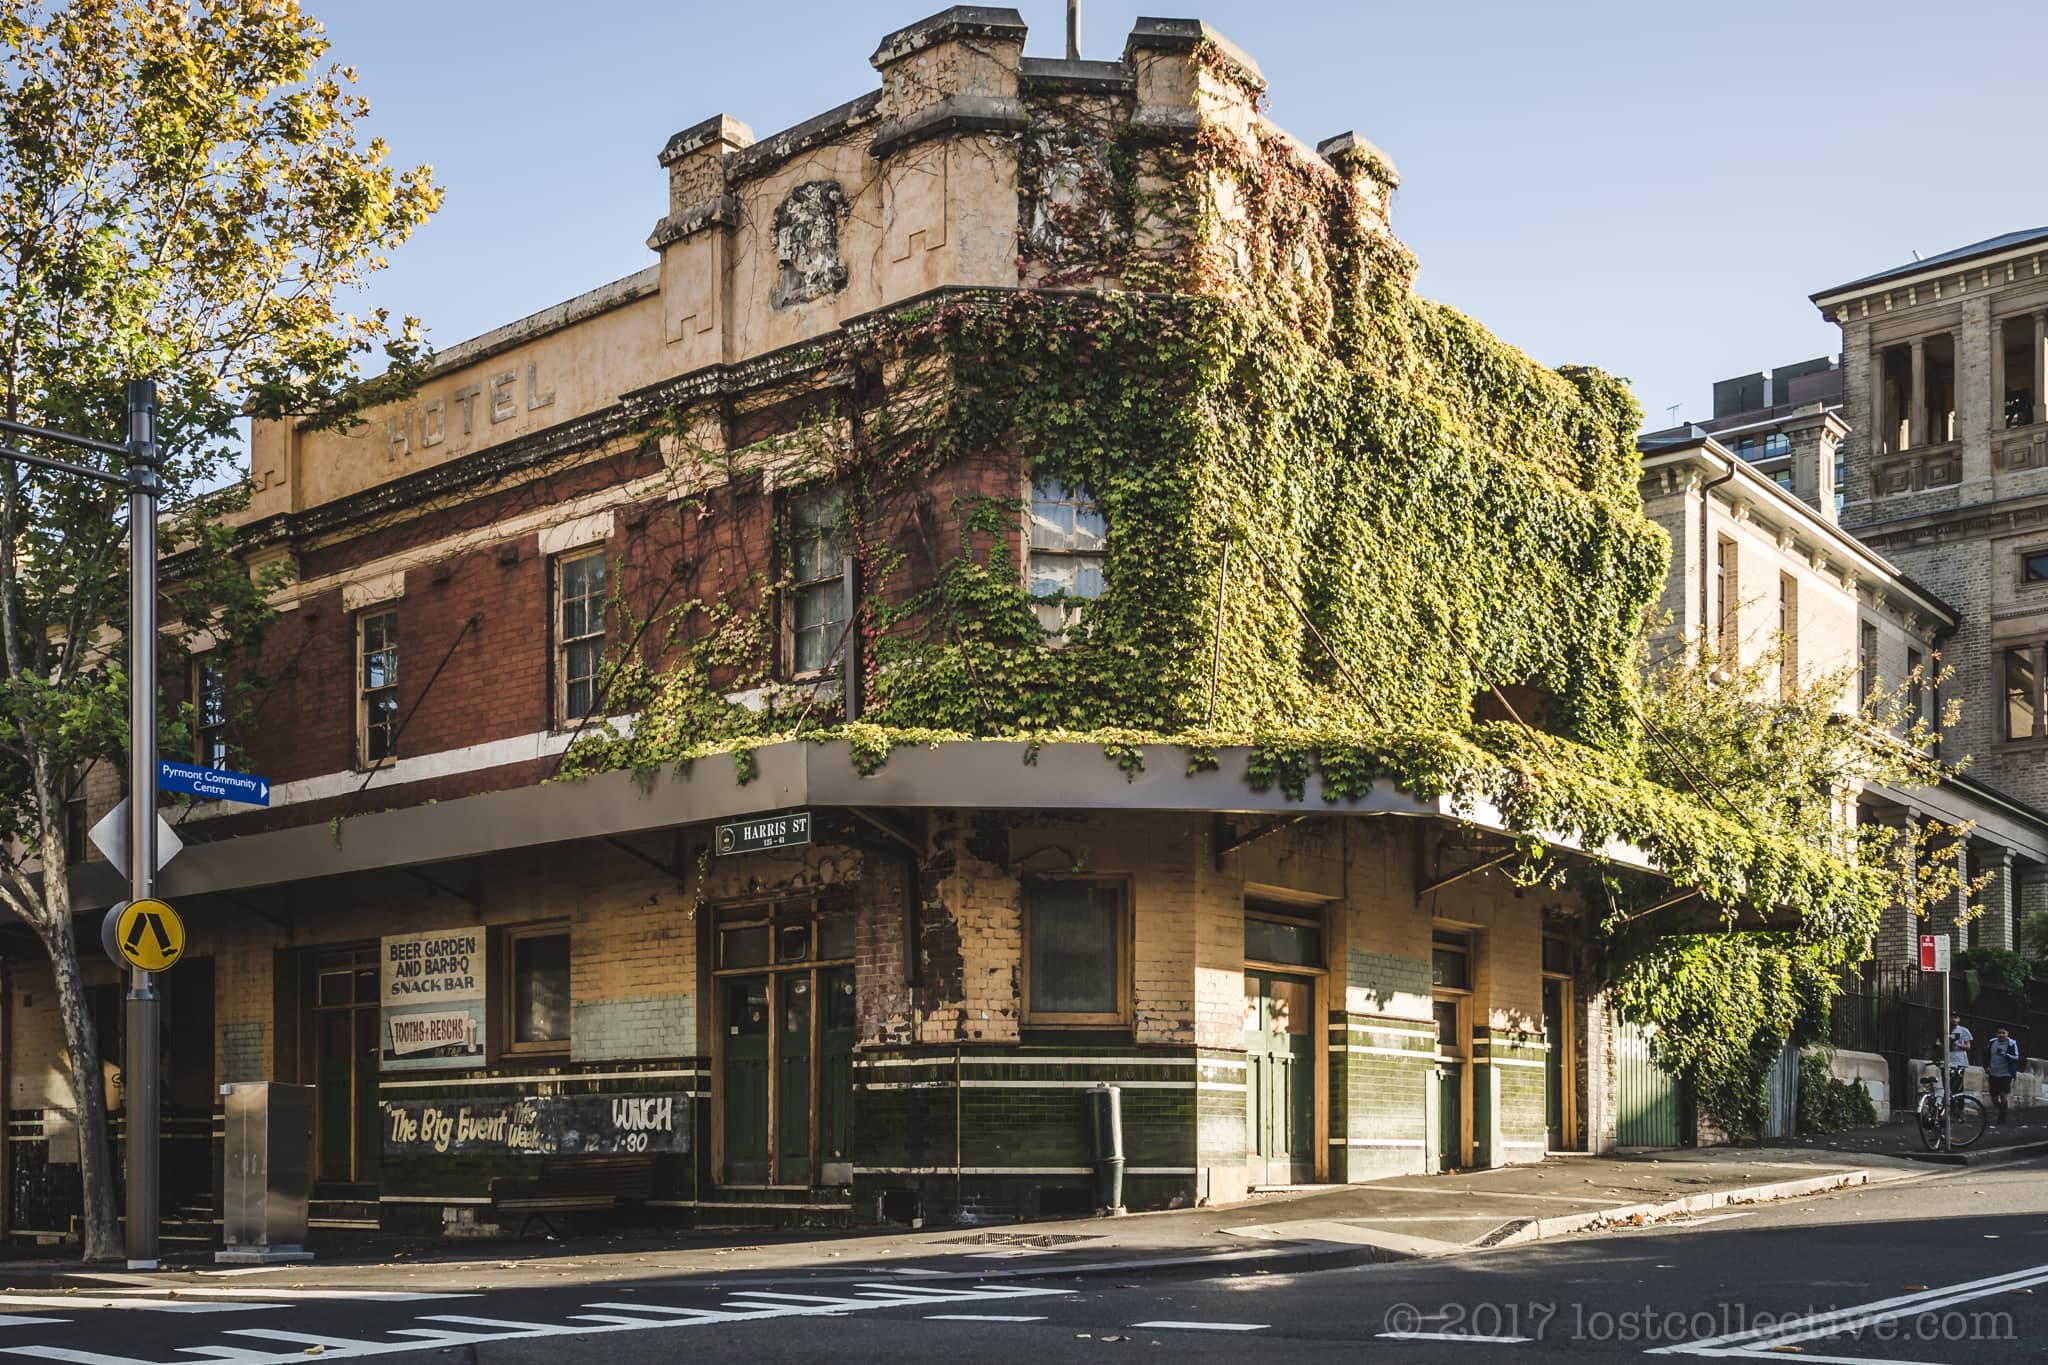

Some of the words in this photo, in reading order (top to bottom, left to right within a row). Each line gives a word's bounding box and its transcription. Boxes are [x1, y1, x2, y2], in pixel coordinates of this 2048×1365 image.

[386, 360, 555, 462] HOTEL
[162, 764, 202, 781] Pyrmont
[204, 771, 256, 791] Community
[193, 780, 226, 795] Centre
[743, 821, 787, 841] HARRIS
[792, 818, 807, 833] ST
[390, 943, 421, 961] BEER
[425, 937, 475, 958] GARDEN
[396, 960, 421, 978] AND
[391, 979, 441, 995] SNACK
[444, 976, 474, 991] BAR
[394, 1020, 424, 1043] TOOTHS
[430, 1017, 463, 1041] RESCHS
[612, 1097, 673, 1131] LUNCH
[421, 1108, 454, 1153] Big
